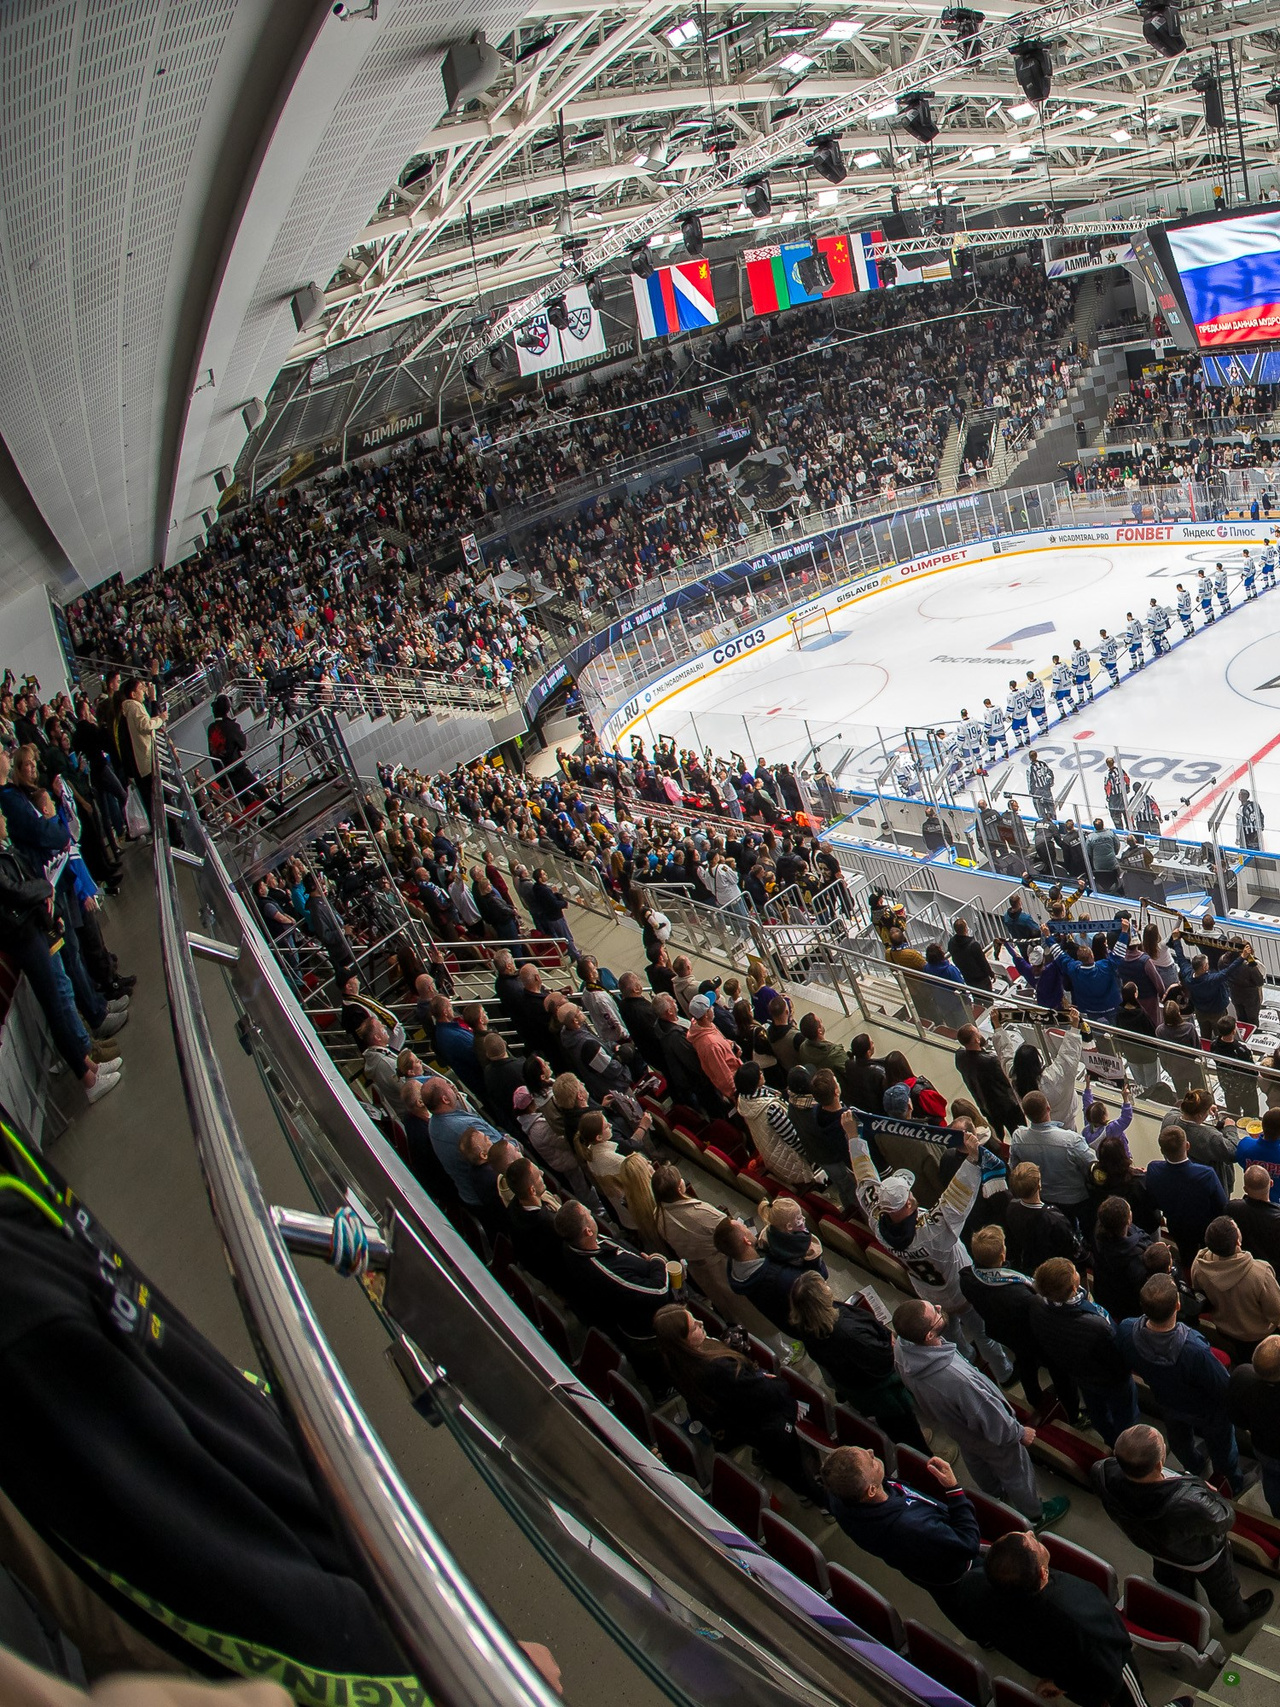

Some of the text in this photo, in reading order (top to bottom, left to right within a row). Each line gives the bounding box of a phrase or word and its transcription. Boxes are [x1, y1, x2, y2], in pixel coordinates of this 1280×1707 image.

[1199, 321, 1232, 334] ПРЕДКАМИ
[1233, 318, 1257, 330] ДАННАЯ
[545, 339, 634, 380] ВЛАДИВОСТОК
[362, 412, 424, 447] АДМИРАЛ
[1058, 532, 1110, 543] HCADMIRAL.PRO
[1116, 526, 1174, 542] FONBET
[1183, 525, 1256, 538] Яндекс Плюс
[900, 550, 968, 576] OLIMPBET
[1146, 567, 1248, 578] LAD
[836, 580, 879, 603] GISLAVED
[929, 655, 1035, 666] Ростелеком
[608, 698, 640, 741] KHL.RU
[1088, 1055, 1121, 1072] АДМИРАЛ
[871, 1119, 952, 1145] Admiral
